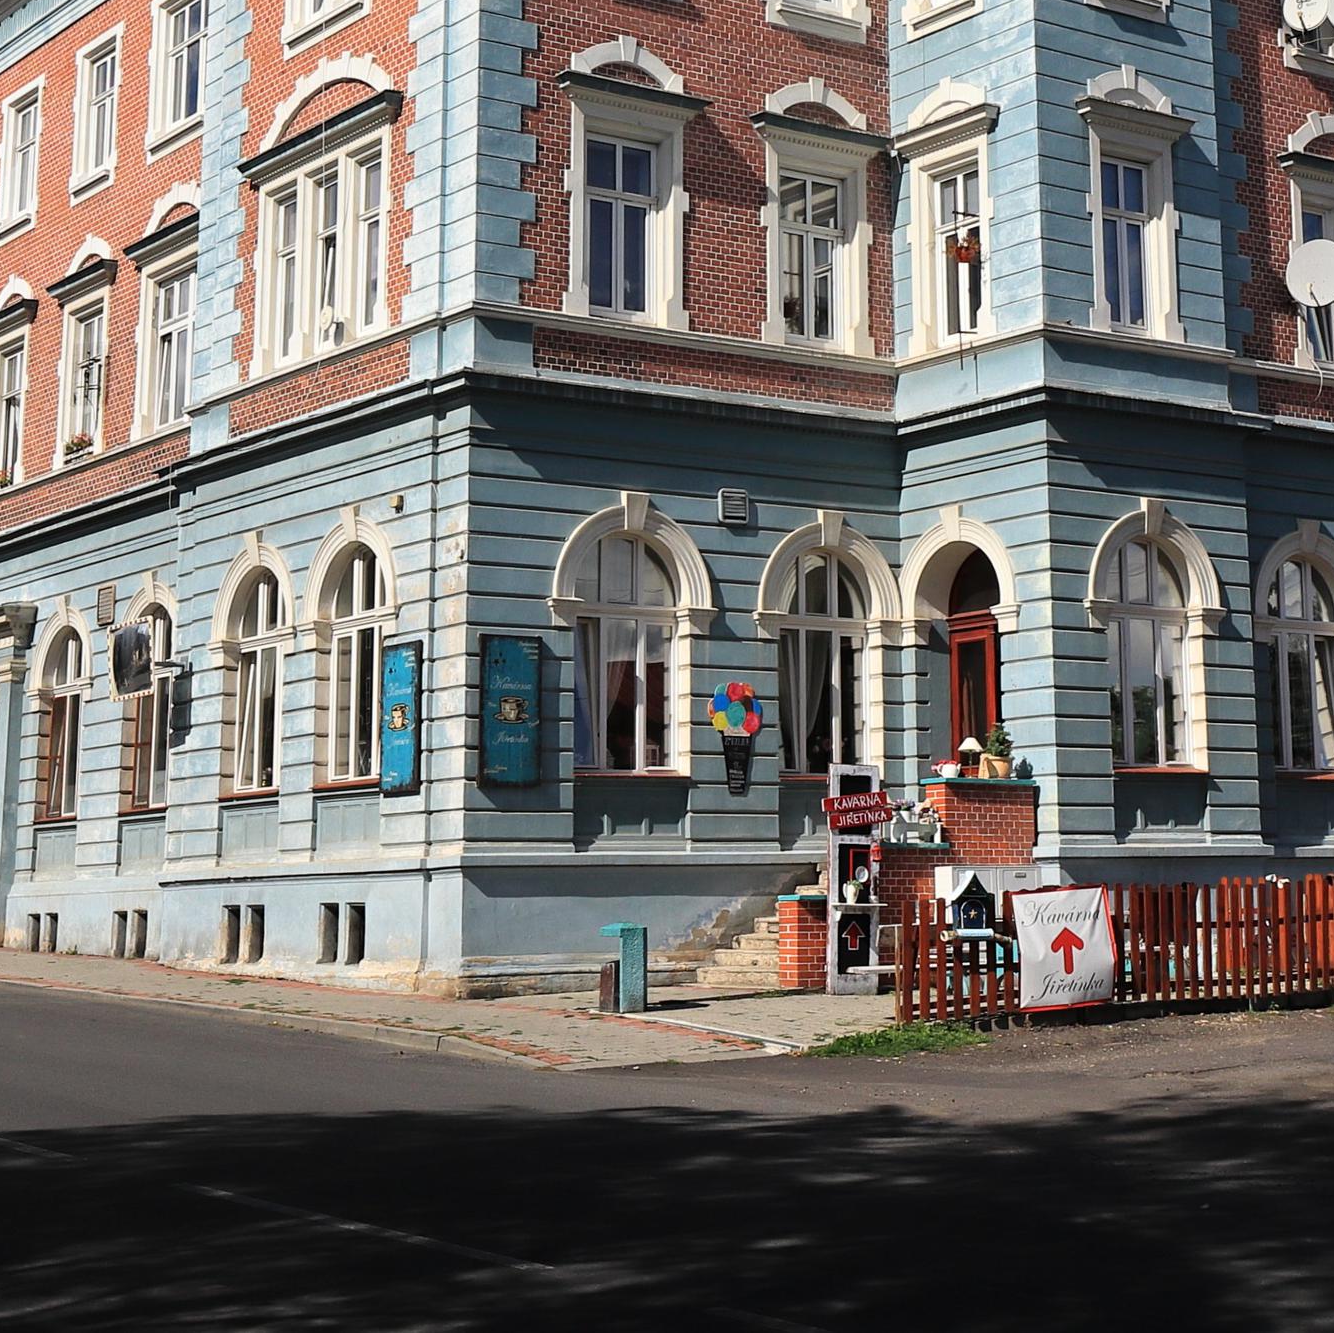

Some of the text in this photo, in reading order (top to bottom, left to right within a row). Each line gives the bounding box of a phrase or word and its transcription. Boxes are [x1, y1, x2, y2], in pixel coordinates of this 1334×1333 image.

[836, 810, 888, 827] JIŘETÍNKA
[1021, 900, 1100, 928] Kavárna
[1030, 970, 1105, 1002] Jiřetínka
